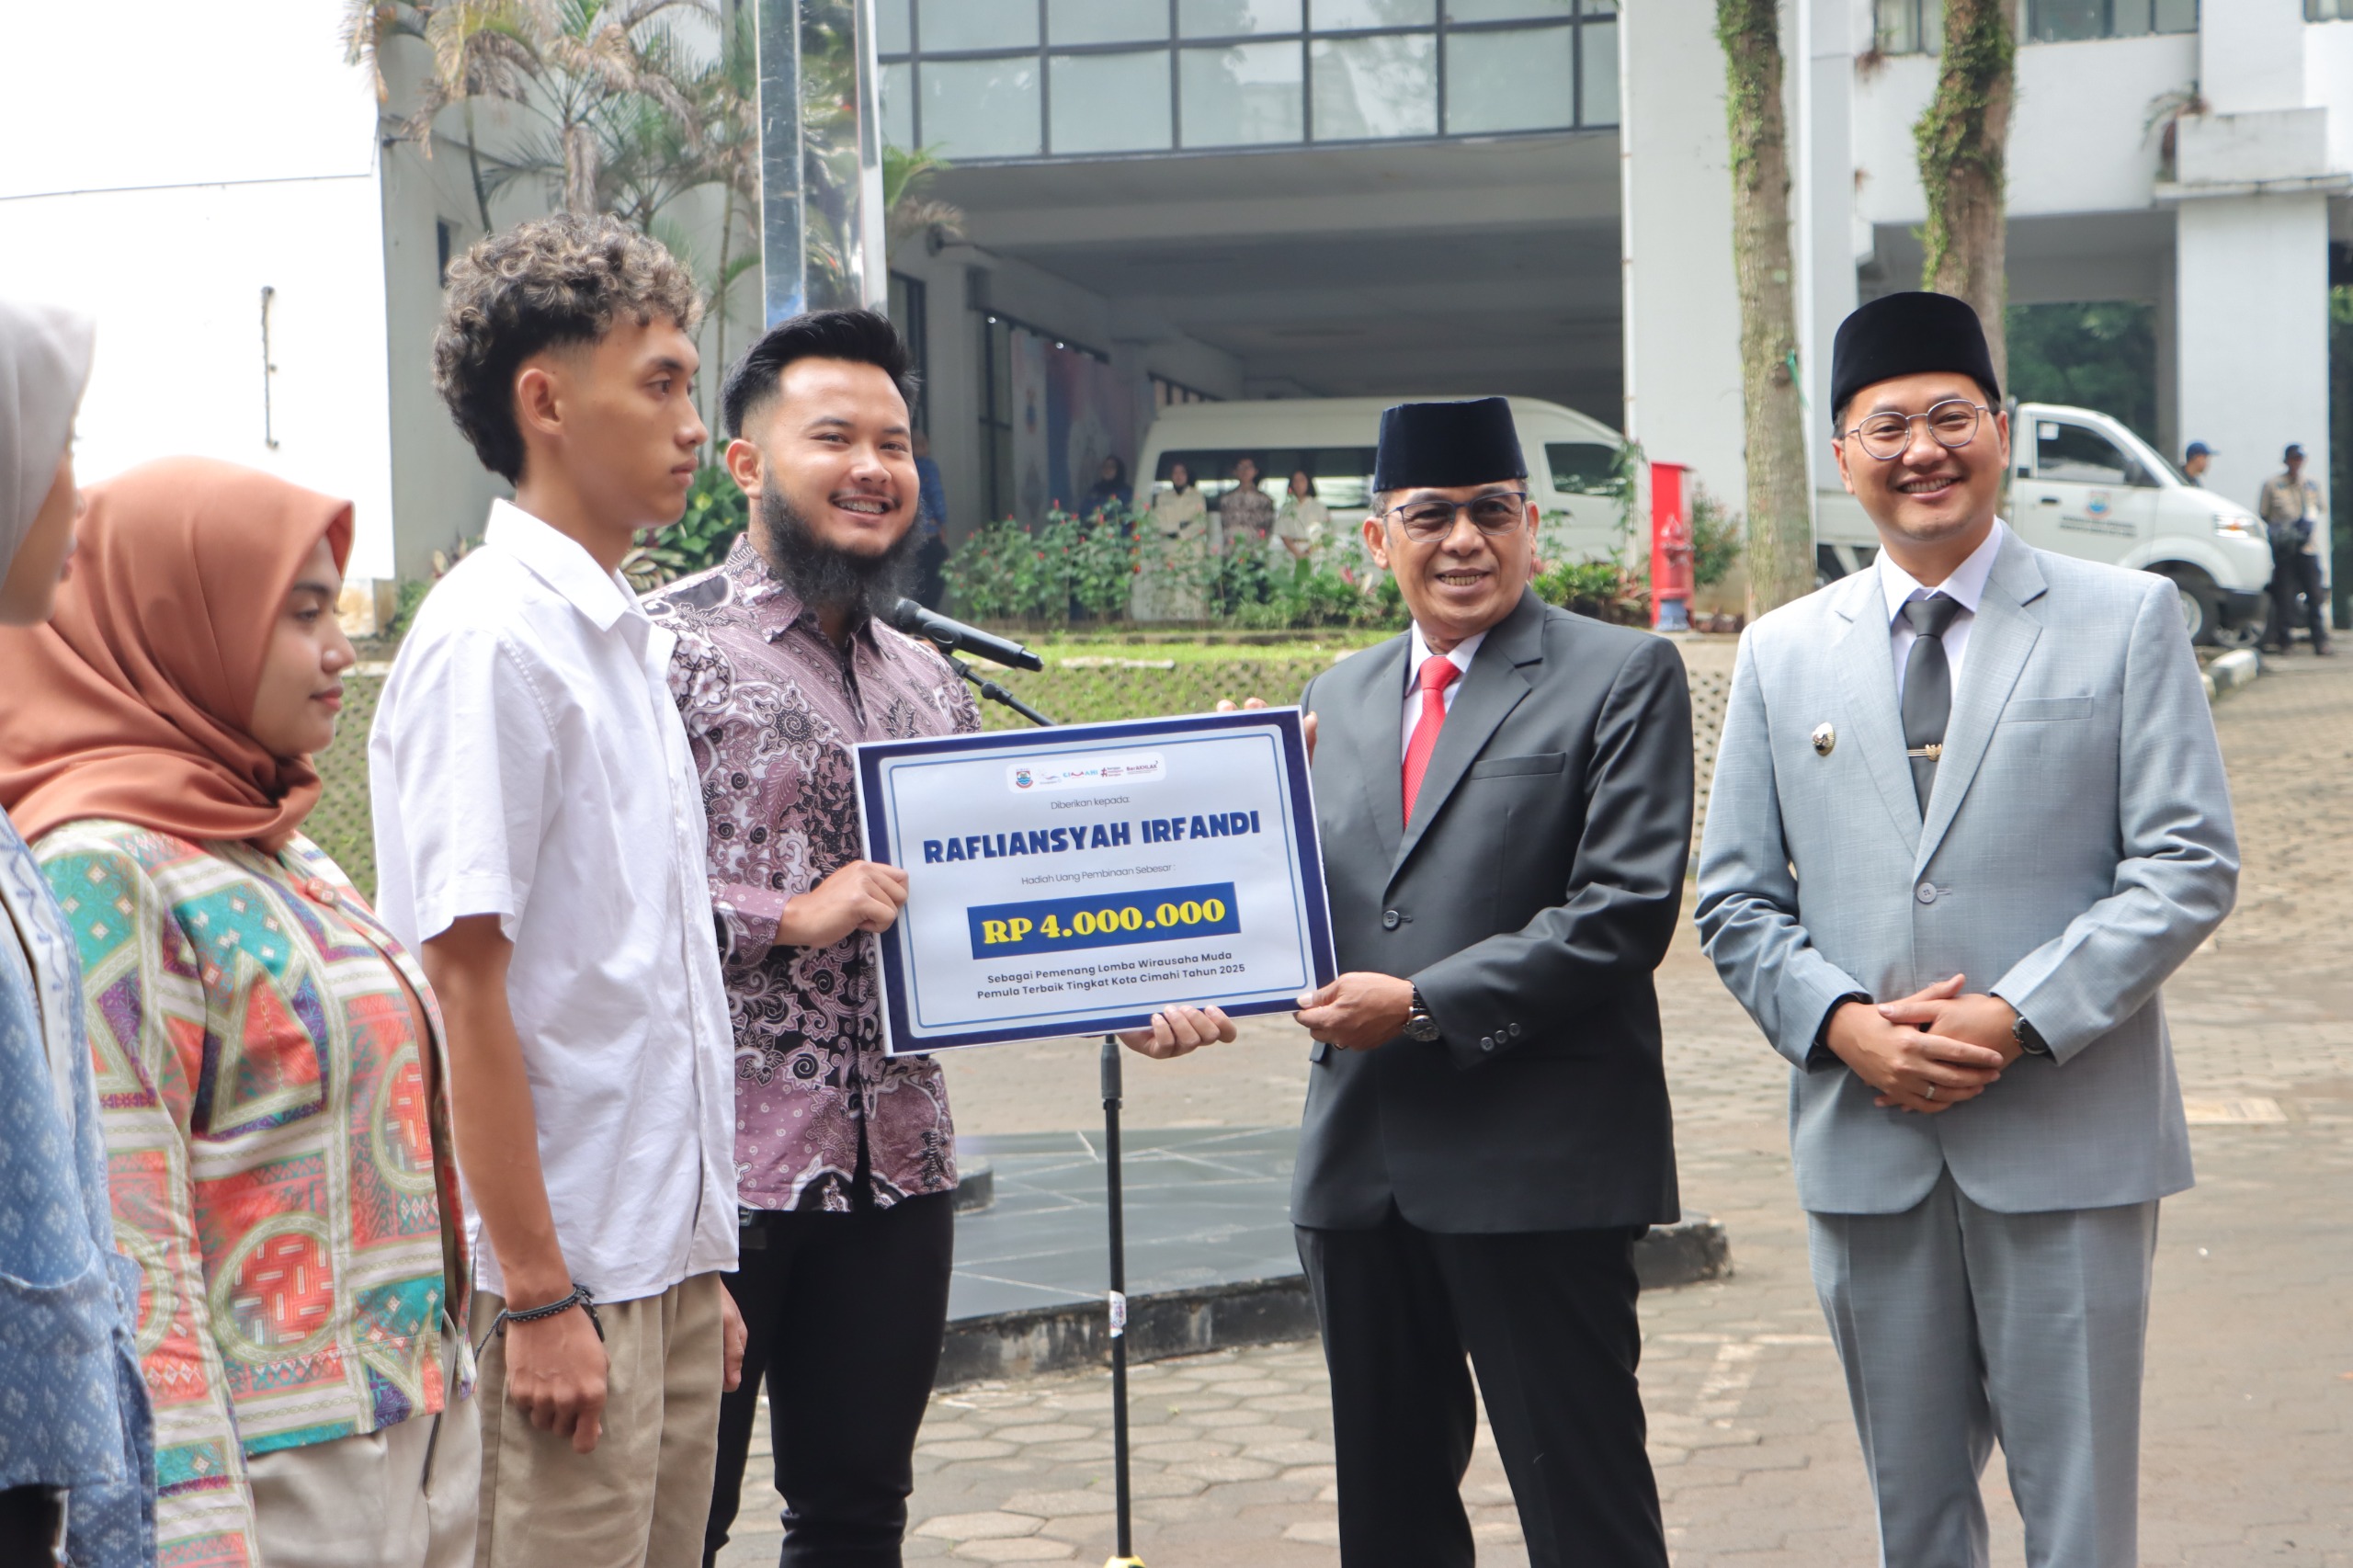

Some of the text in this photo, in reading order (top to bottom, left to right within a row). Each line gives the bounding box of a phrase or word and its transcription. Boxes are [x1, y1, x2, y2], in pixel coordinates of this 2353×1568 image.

[1051, 795, 1131, 810] Diberikan kepada:
[923, 810, 1261, 864] RAFLIANSYAH IRFANDI
[1021, 874, 1055, 885] Hadiah
[1056, 872, 1081, 883] Uang
[1082, 868, 1134, 880] Pembinaan
[1135, 863, 1173, 874] Sebesar
[982, 898, 1226, 944] RP 4.000.000
[977, 963, 1245, 999] Pemula Terbaik Tingkat Kota Cimahi Tahun 2025
[987, 951, 1233, 983] Sebagai Pemenang Lomba Wirausaha Muda
